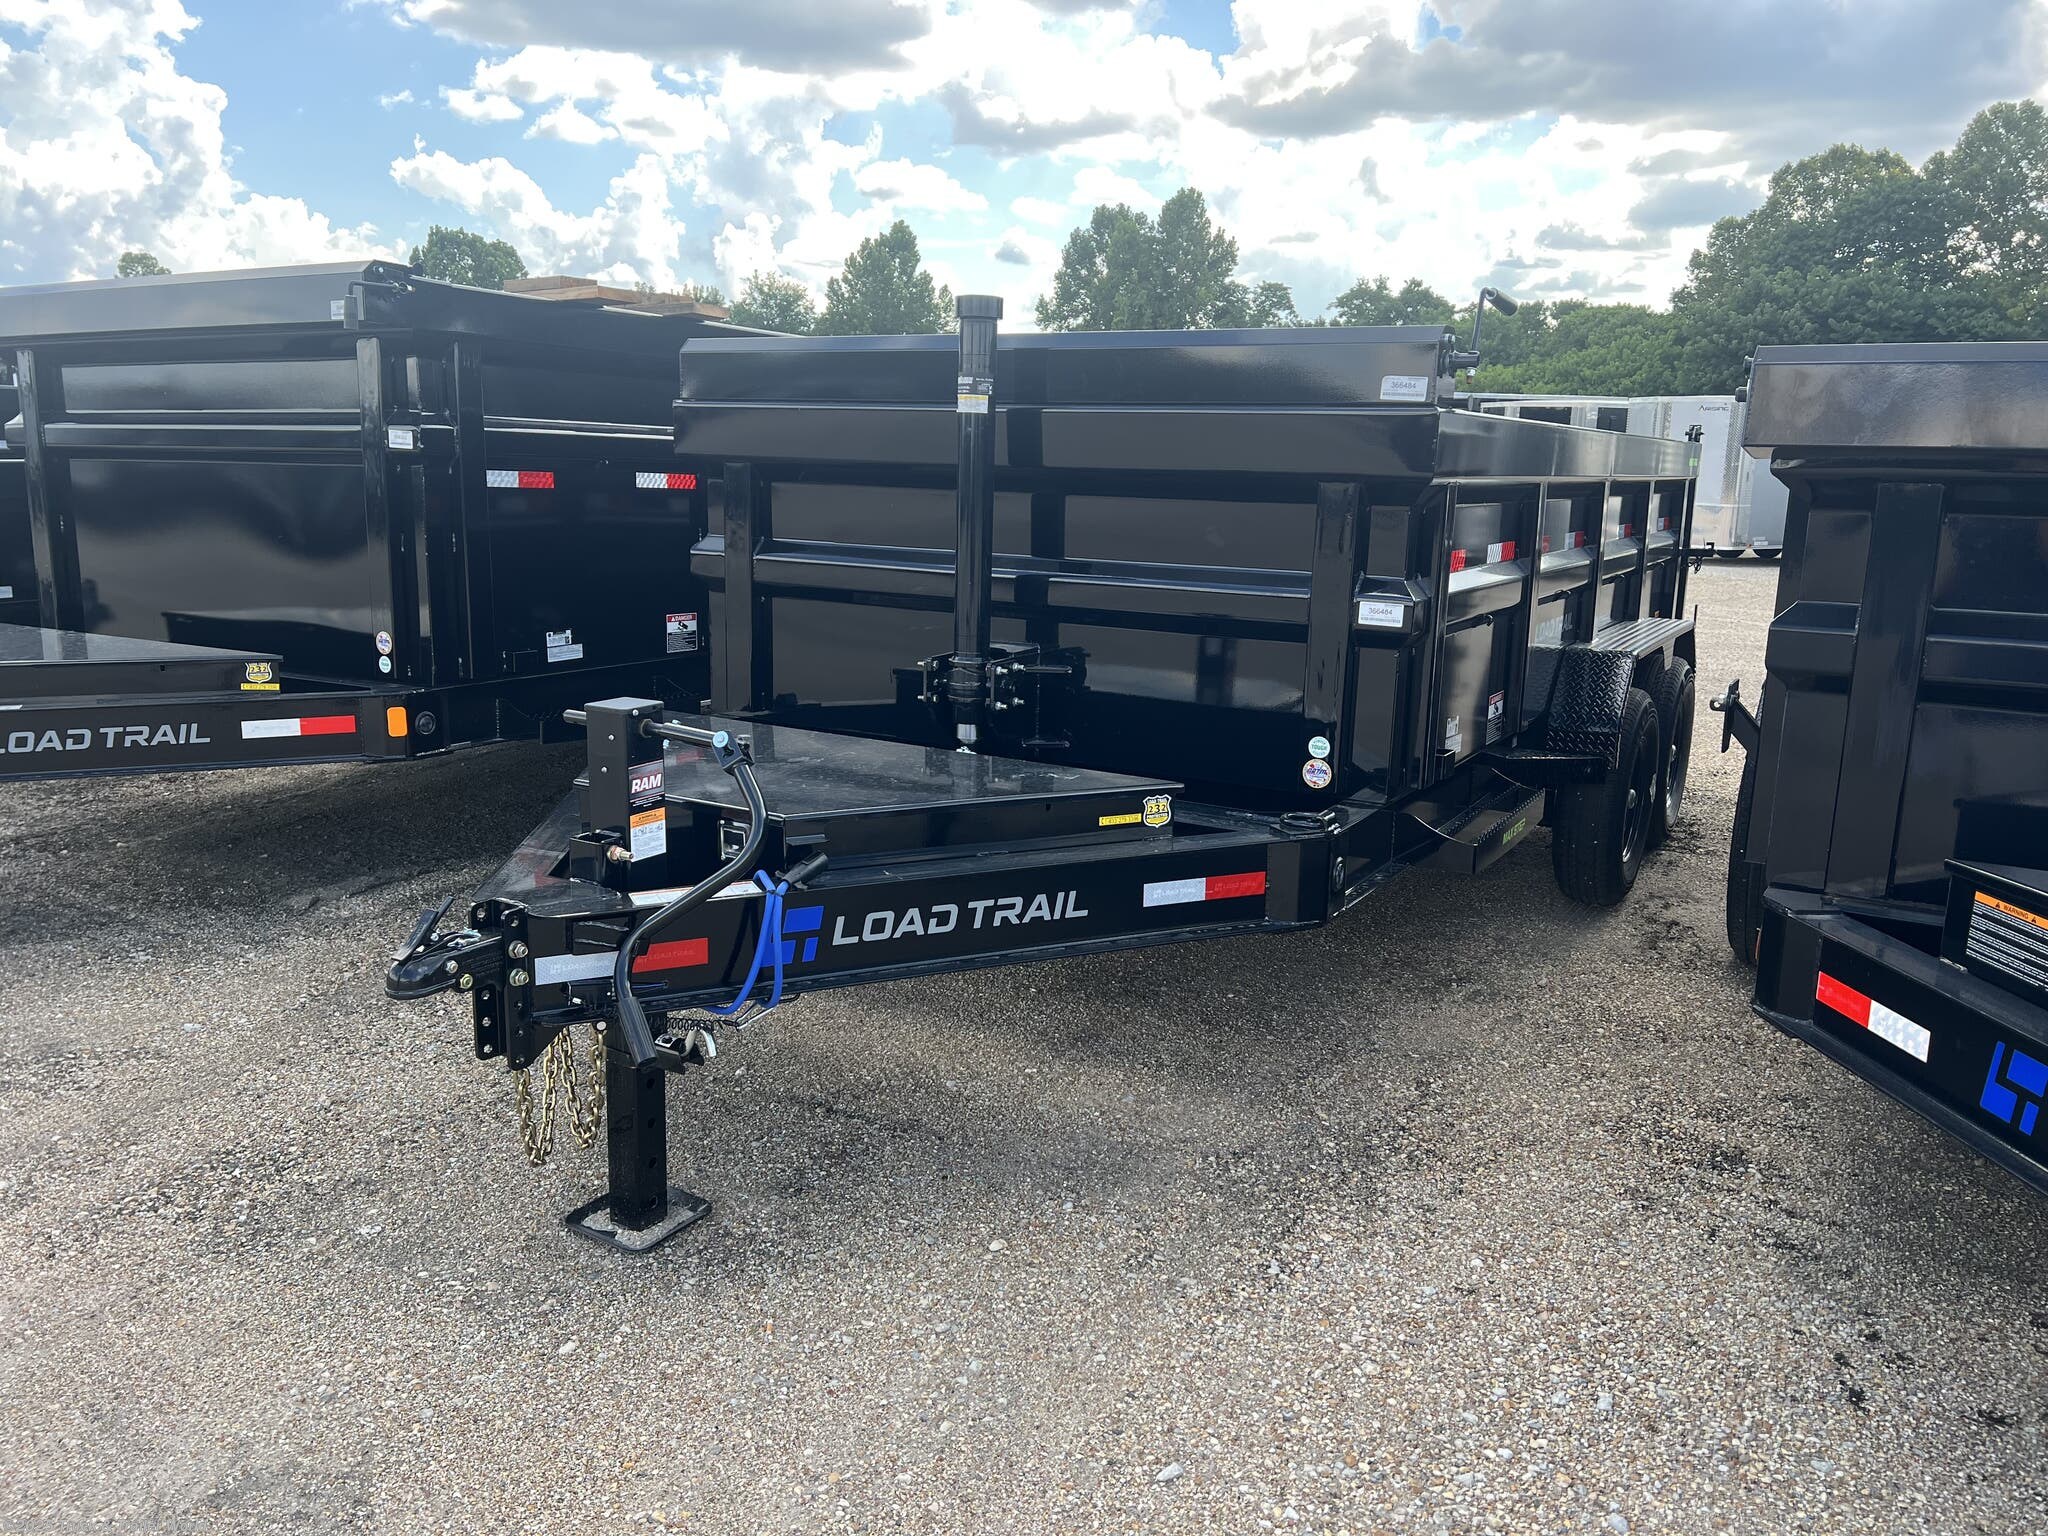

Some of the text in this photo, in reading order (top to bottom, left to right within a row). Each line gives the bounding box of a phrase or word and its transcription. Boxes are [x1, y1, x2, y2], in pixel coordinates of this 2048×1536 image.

[0, 723, 212, 755] OAD TRAIL
[631, 773, 662, 794] RAM
[1148, 804, 1167, 814] 232
[831, 901, 959, 946] LOAD
[967, 890, 1089, 929] TRAIL
[2003, 904, 2029, 920] WARNING
